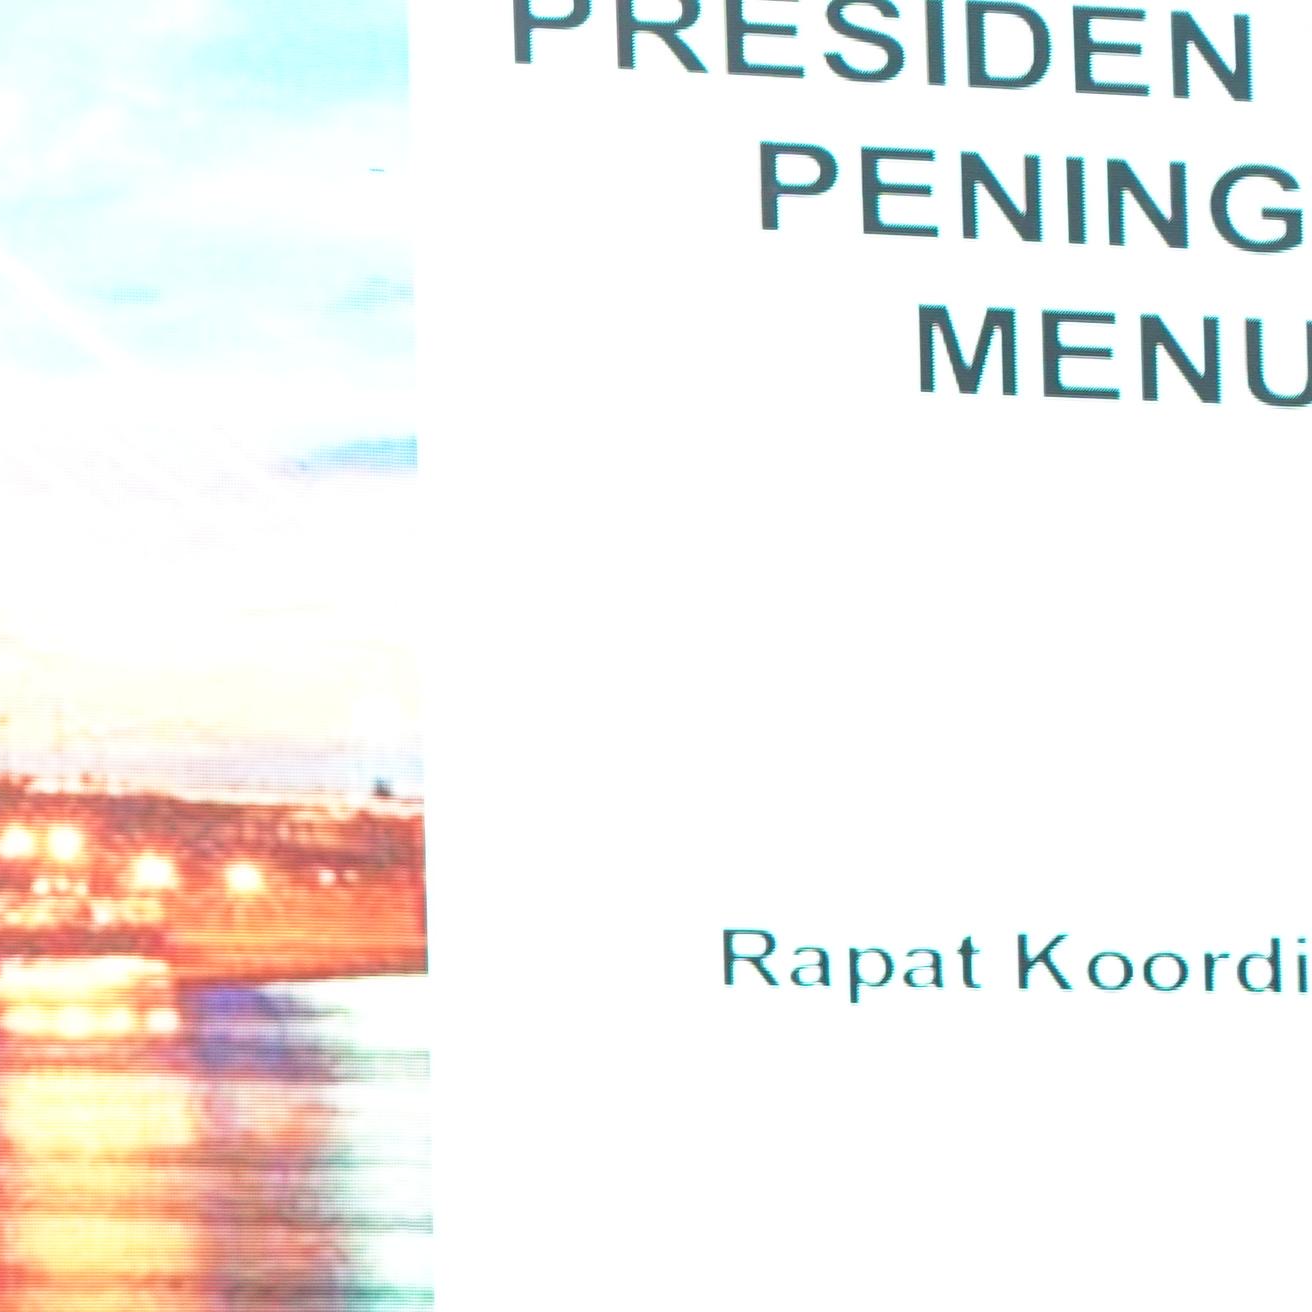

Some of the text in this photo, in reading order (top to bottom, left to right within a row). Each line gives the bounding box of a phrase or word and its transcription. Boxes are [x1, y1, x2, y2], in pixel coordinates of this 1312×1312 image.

[512, 0, 1254, 102] PRESIDEN
[759, 140, 1304, 254] PENING
[918, 303, 1312, 408] MENU
[722, 928, 1309, 1004] Rapat Koordi
